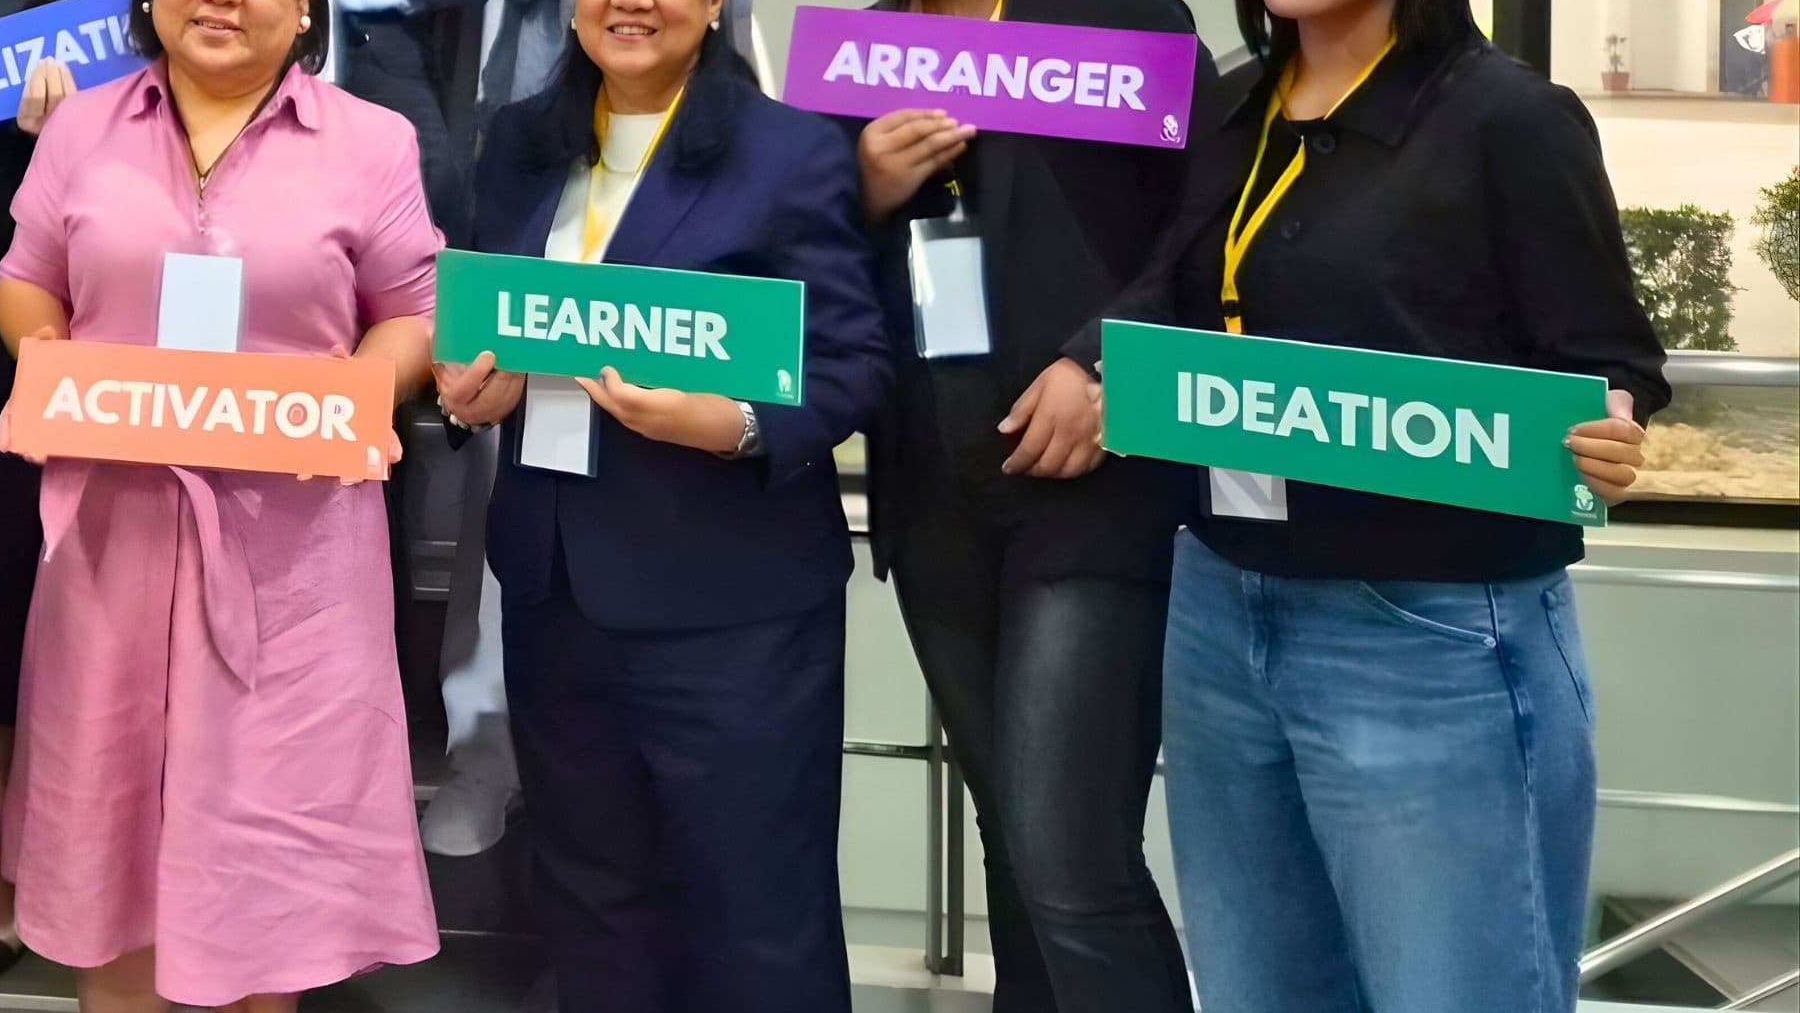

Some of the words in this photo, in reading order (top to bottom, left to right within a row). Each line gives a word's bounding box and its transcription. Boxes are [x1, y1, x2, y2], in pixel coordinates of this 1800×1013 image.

[823, 40, 1147, 111] ARRANGER
[497, 291, 732, 361] LEARNER
[43, 376, 358, 441] ACTIVATOR
[1177, 371, 1510, 469] IDEATION
